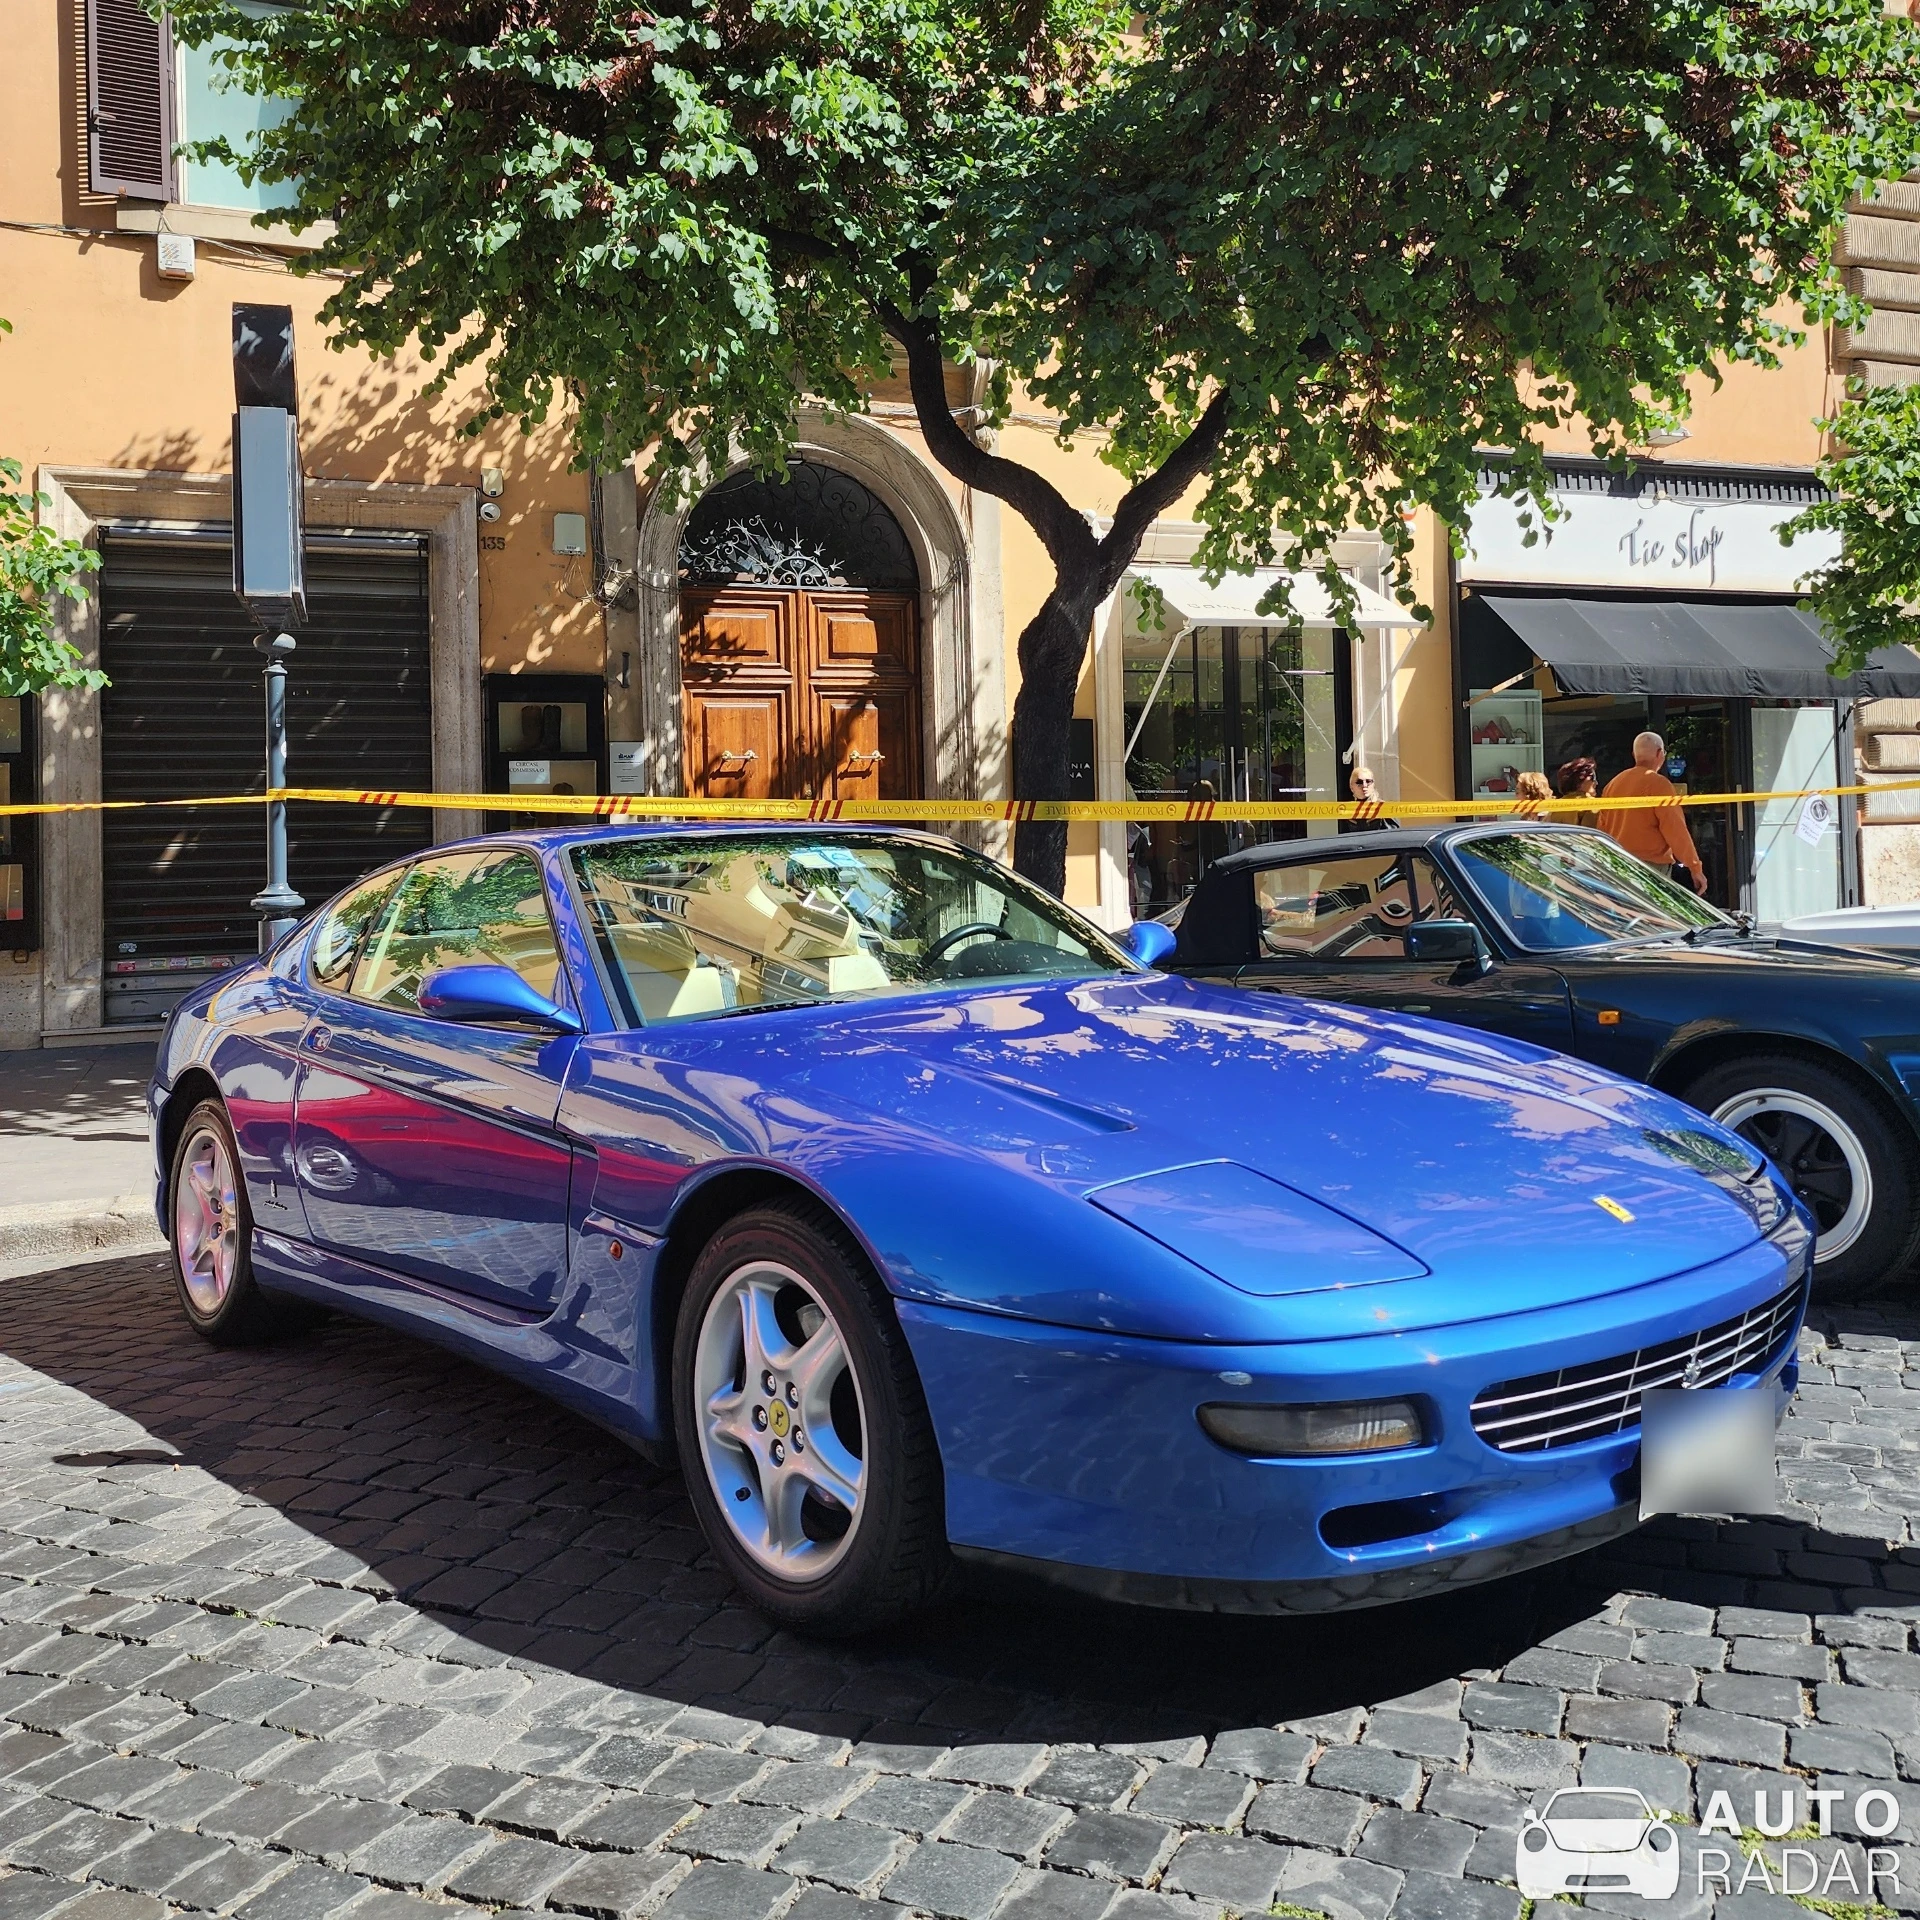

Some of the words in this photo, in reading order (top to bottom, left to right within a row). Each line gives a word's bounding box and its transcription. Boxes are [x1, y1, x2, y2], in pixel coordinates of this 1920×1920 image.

[480, 536, 506, 550] 135
[1671, 507, 1724, 588] Shop
[698, 802, 736, 812] ROMA
[852, 805, 901, 815] CAPITALE
[903, 805, 938, 815] ROMA
[940, 805, 982, 815] POLIZIA
[1046, 806, 1090, 815] CAPITALE
[1093, 806, 1123, 815] ROMA
[1126, 806, 1164, 815] POLIZIA
[1222, 806, 1265, 815] CAPITALE
[1267, 806, 1297, 815] ROMA
[1299, 806, 1334, 815] POLIZIA
